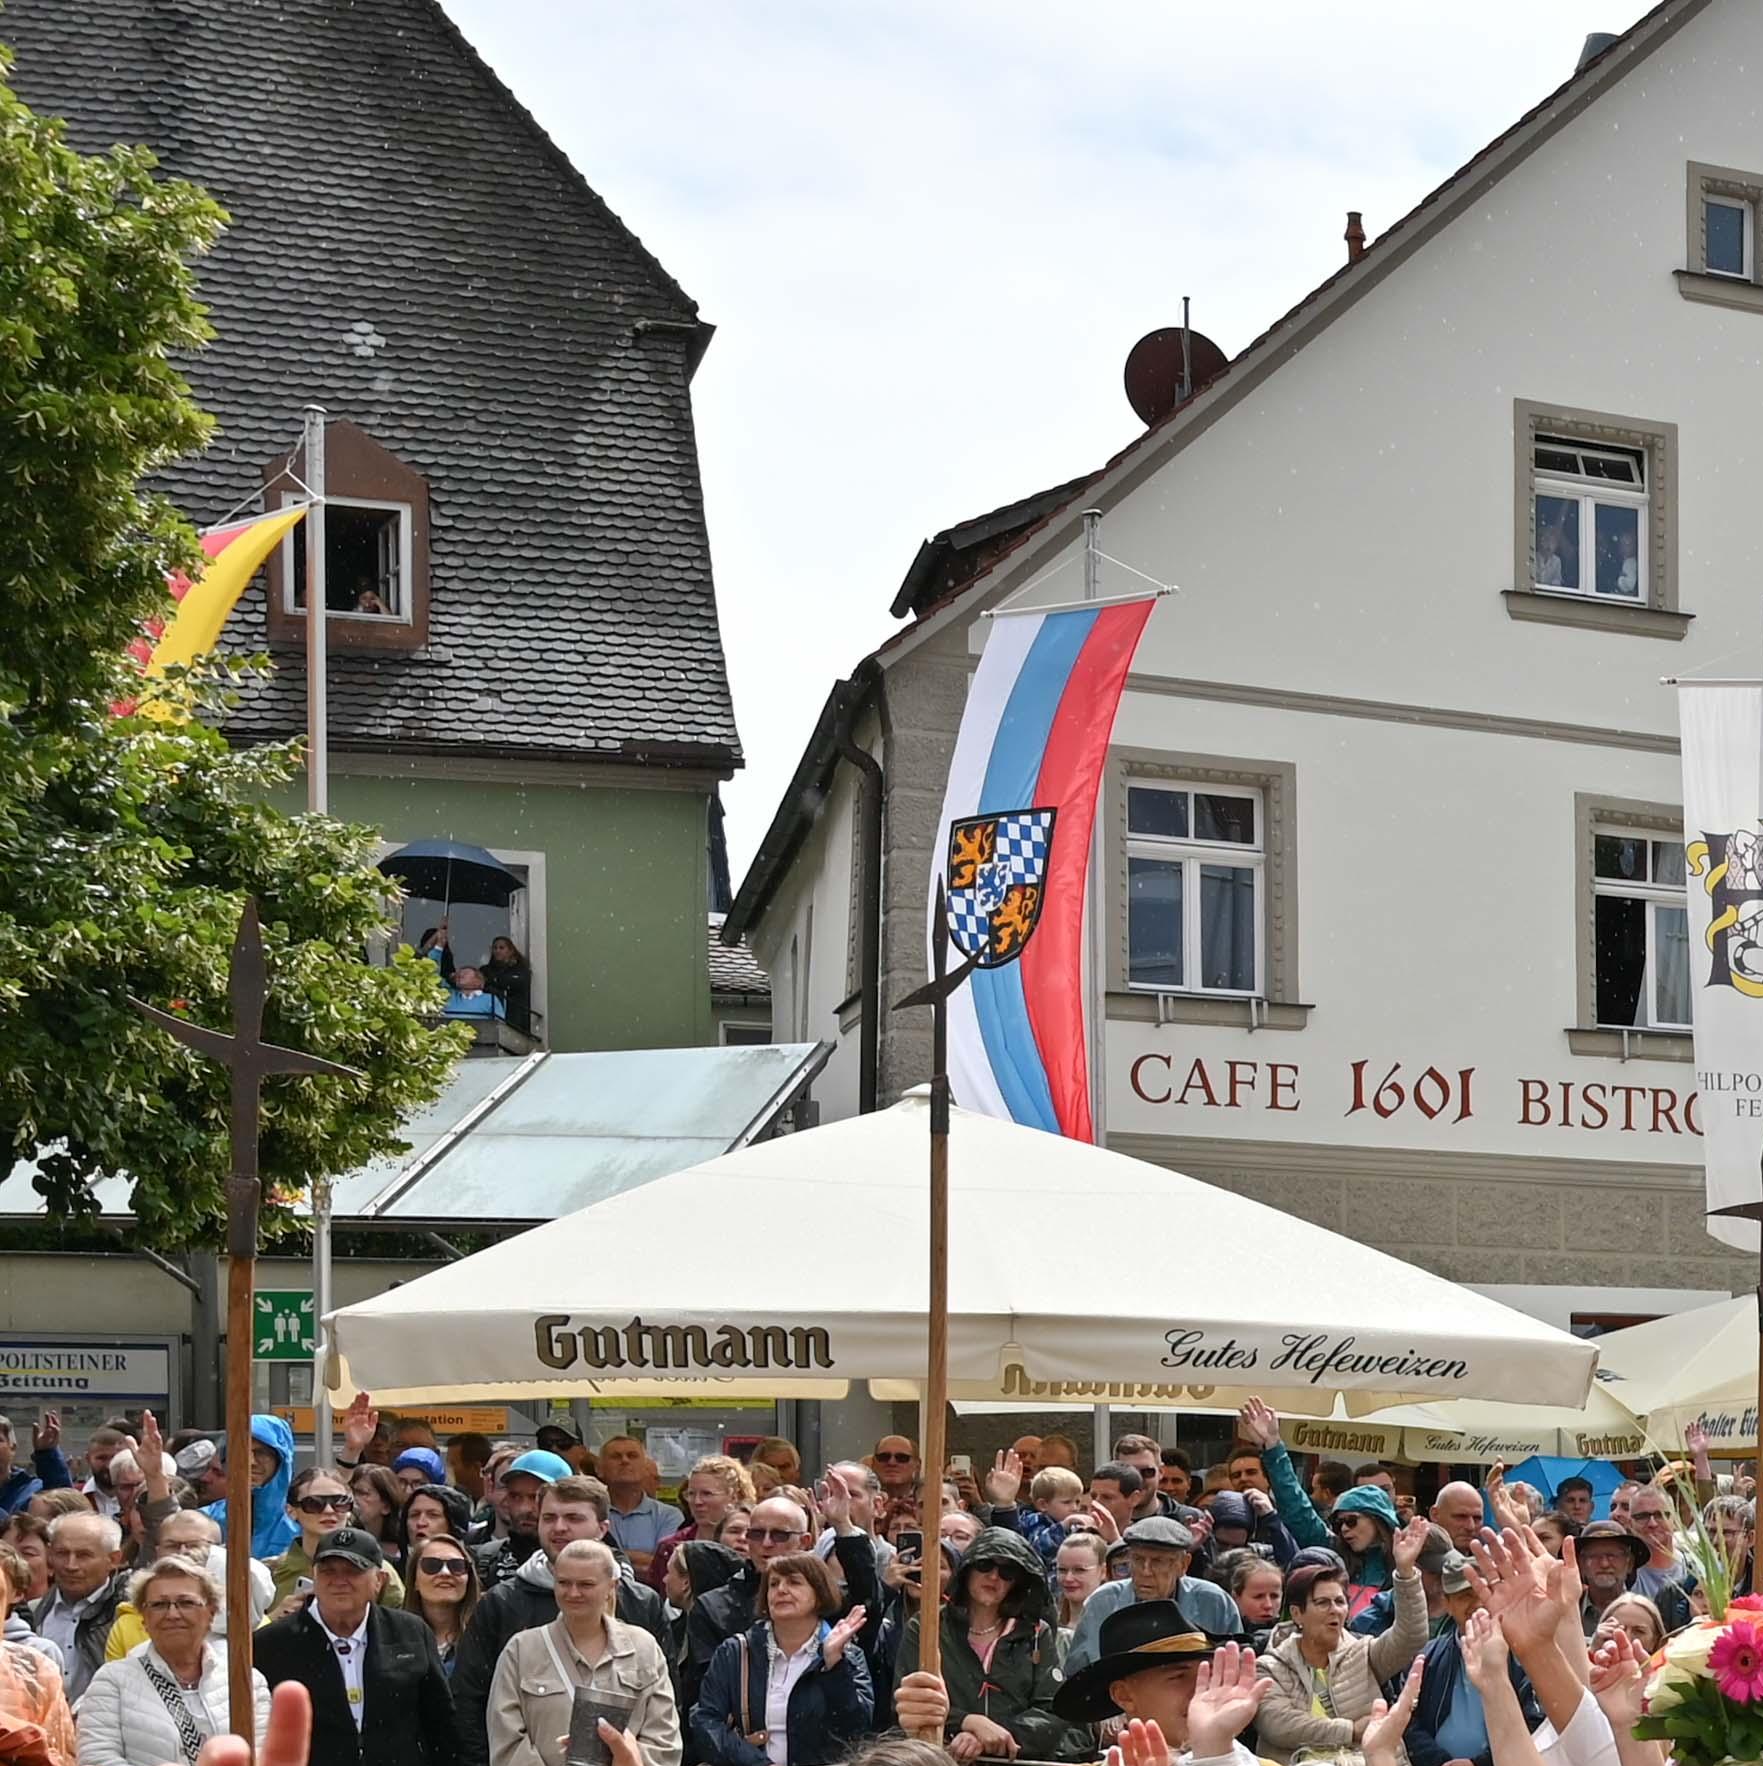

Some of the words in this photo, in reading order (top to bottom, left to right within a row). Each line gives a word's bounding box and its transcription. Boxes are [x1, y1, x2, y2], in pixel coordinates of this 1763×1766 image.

[1130, 1053, 1301, 1112] CAFE
[1344, 1059, 1475, 1125] 1601
[534, 1314, 835, 1370] Gutmann
[1161, 1329, 1258, 1369] Gutes
[1269, 1334, 1469, 1384] Hefeweizen
[1292, 1422, 1386, 1454] Gutmann
[1424, 1434, 1461, 1452] Gutes
[1464, 1435, 1540, 1456] Hefeweizen
[1576, 1432, 1645, 1457] Gutma
